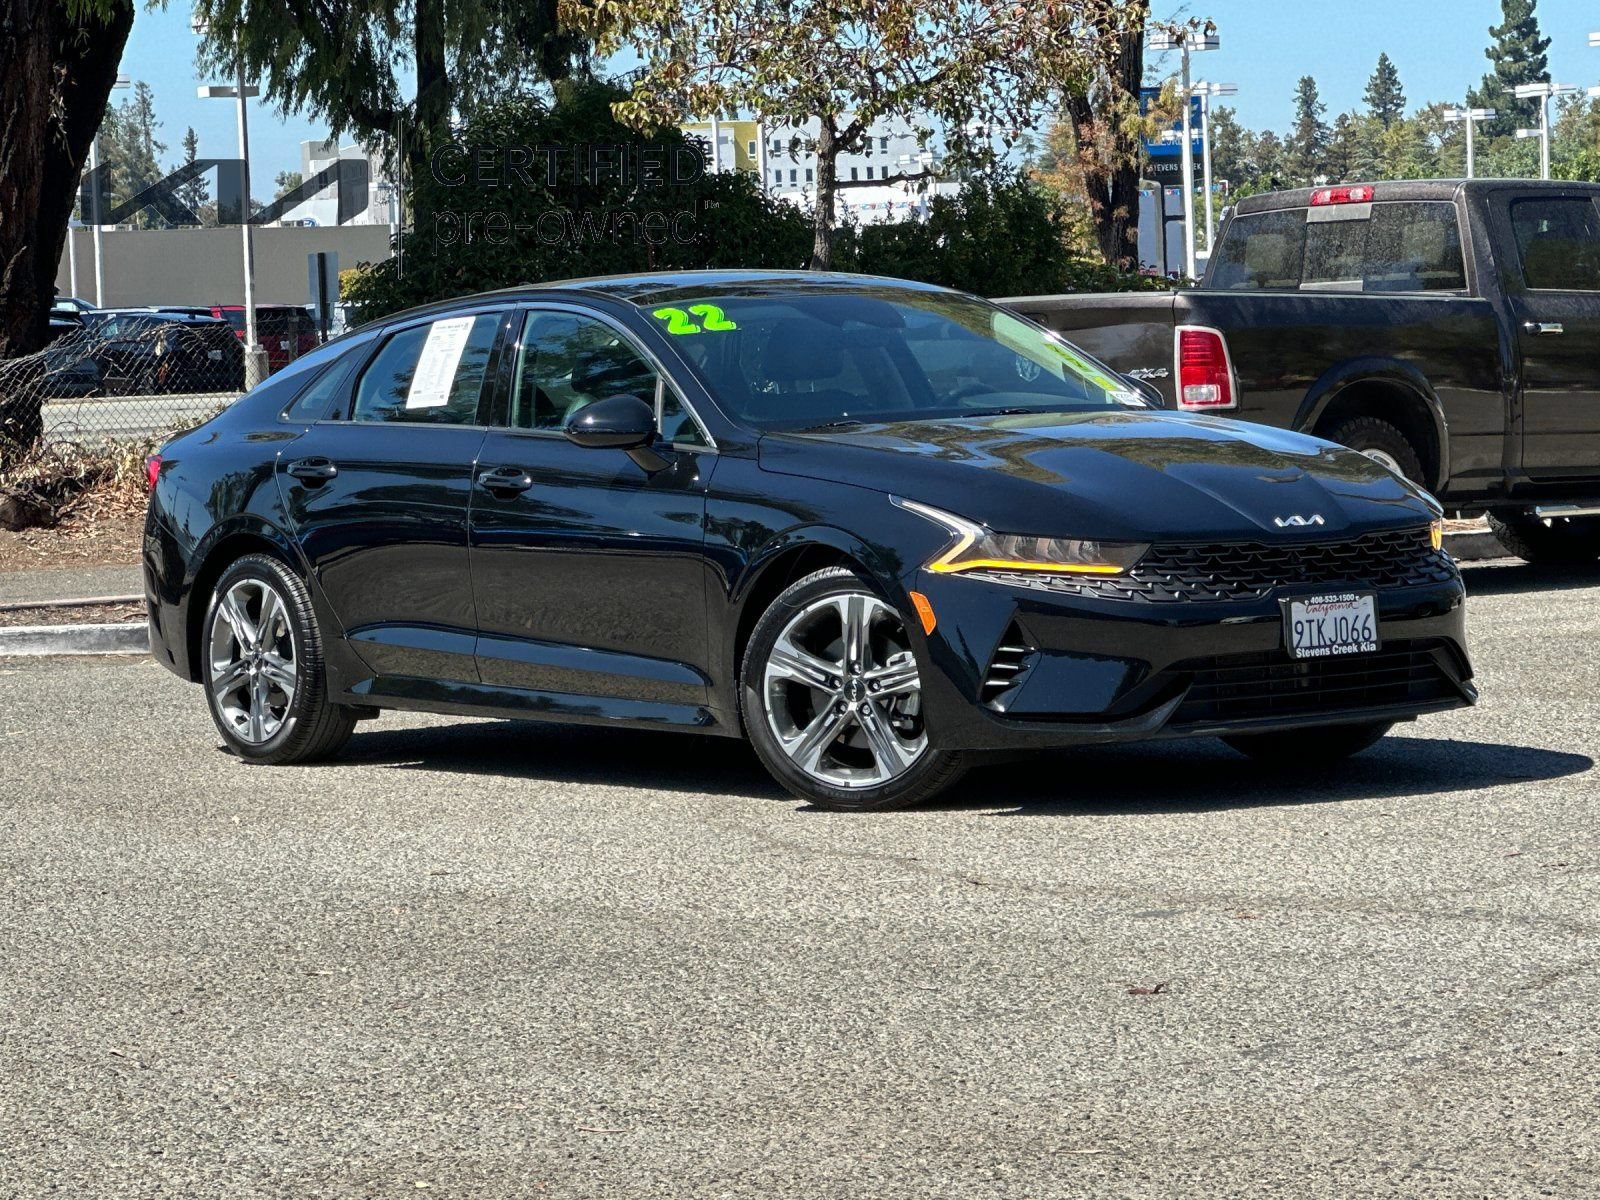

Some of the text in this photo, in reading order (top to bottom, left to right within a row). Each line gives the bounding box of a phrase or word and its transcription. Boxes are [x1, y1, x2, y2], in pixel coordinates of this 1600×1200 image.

[1180, 162, 1202, 171] CEK
[652, 304, 737, 335] 22
[1305, 601, 1359, 616] California
[1294, 613, 1372, 648] 9TKJ066
[1295, 641, 1376, 658] Stevens Creek Kia
